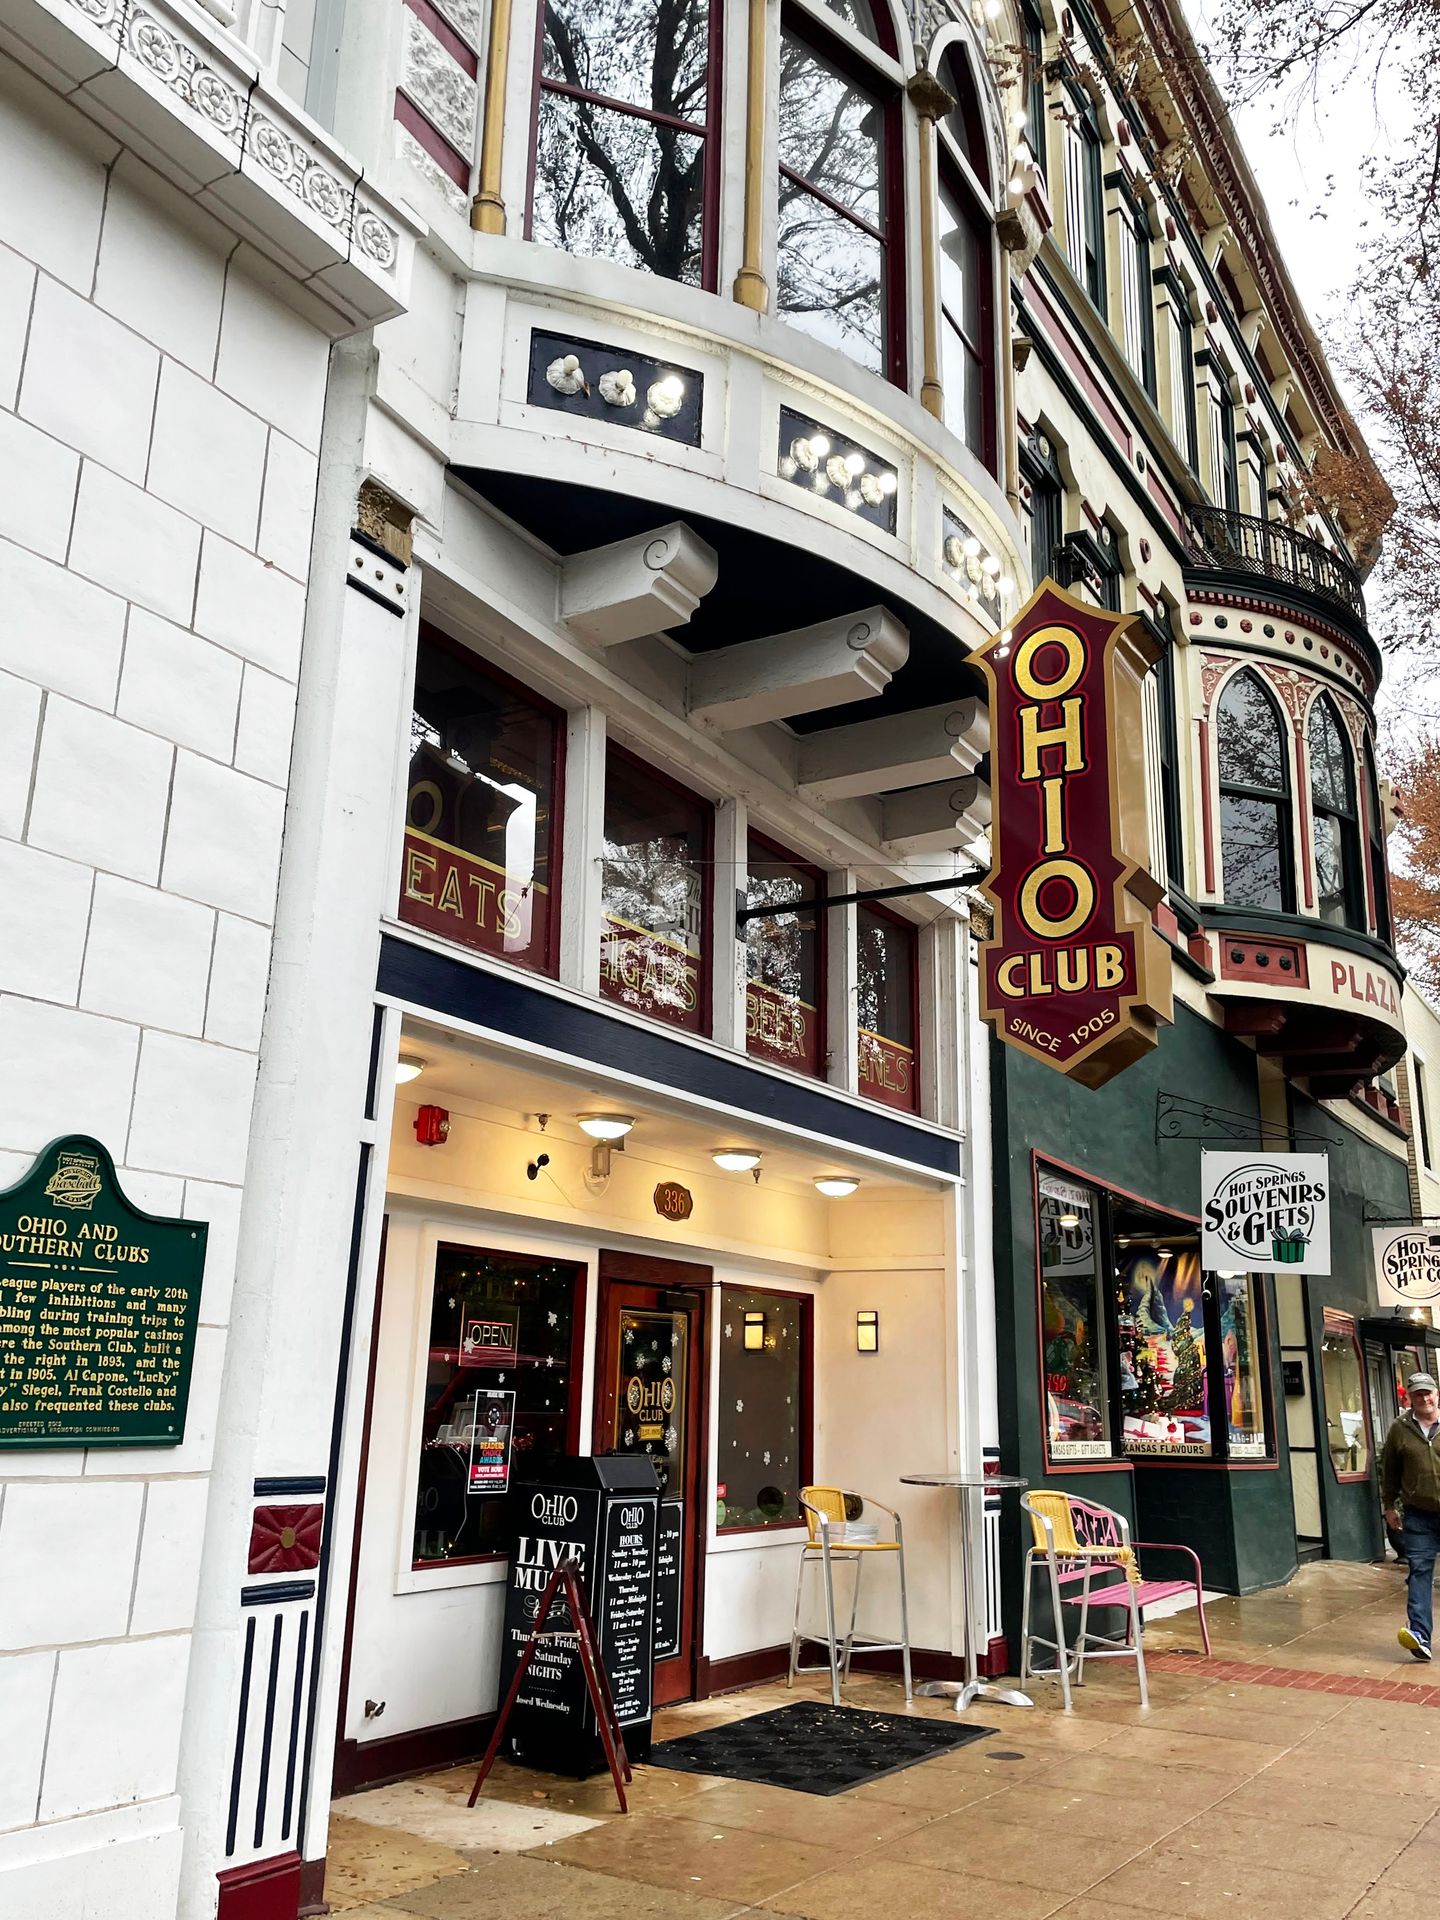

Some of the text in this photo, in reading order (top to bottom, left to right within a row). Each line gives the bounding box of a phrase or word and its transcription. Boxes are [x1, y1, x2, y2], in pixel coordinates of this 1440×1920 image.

[1014, 626, 1094, 938] OHIO
[403, 847, 522, 939] EATS
[997, 945, 1124, 997] CLUB
[1330, 960, 1398, 1018] PLAZA
[746, 991, 806, 1057] BEER
[1010, 1008, 1115, 1052] SINCE 1905
[1229, 1171, 1306, 1198] HOT SPRINGS
[664, 1189, 685, 1214] 336
[1205, 1182, 1326, 1232] SOUVENIRS
[18, 1215, 118, 1242] OHIO AND
[1227, 1206, 1310, 1246] & GIFTS
[0, 1234, 150, 1263] UTHERN CLUBS
[1397, 1239, 1426, 1258] HOT
[0, 1278, 188, 1299] eague players of the early 20th
[1397, 1268, 1423, 1289] HAT
[15, 1291, 187, 1314] few inhibitions and many
[40, 1308, 80, 1323] during
[87, 1310, 134, 1326] training
[141, 1313, 167, 1327] trips
[174, 1316, 185, 1327] to
[40, 1323, 60, 1336] the
[62, 1325, 91, 1337] most
[95, 1327, 139, 1339] popular
[144, 1330, 184, 1341] casinos
[471, 1325, 509, 1346] OPEN
[23, 1338, 43, 1350] the
[48, 1338, 101, 1352] Southern
[143, 1342, 170, 1354] built
[175, 1346, 182, 1354] a
[4, 1353, 26, 1365] the
[35, 1353, 67, 1367] right
[76, 1355, 89, 1366] in
[136, 1357, 156, 1368] and
[162, 1357, 181, 1369] the
[9, 1368, 23, 1380] in
[64, 1369, 78, 1381] Al
[21, 1384, 62, 1397] Siegel,
[69, 1384, 103, 1396] Frank
[107, 1385, 152, 1397] Costello
[156, 1386, 177, 1397] and
[627, 1376, 677, 1414] OHIO
[2, 1398, 175, 1414] also frequented these clubs.
[639, 1409, 664, 1421] CLUB
[1160, 1444, 1204, 1454] FLAVOURS
[531, 1493, 578, 1522] OHIO
[620, 1506, 645, 1526] OHIO
[541, 1515, 565, 1526] CLUB
[619, 1534, 643, 1546] HOURS
[516, 1536, 586, 1572] LIVE
[534, 1649, 573, 1668] Saturday
[527, 1664, 562, 1681] NIGHTS
[516, 1694, 571, 1715] losed Wednesday
